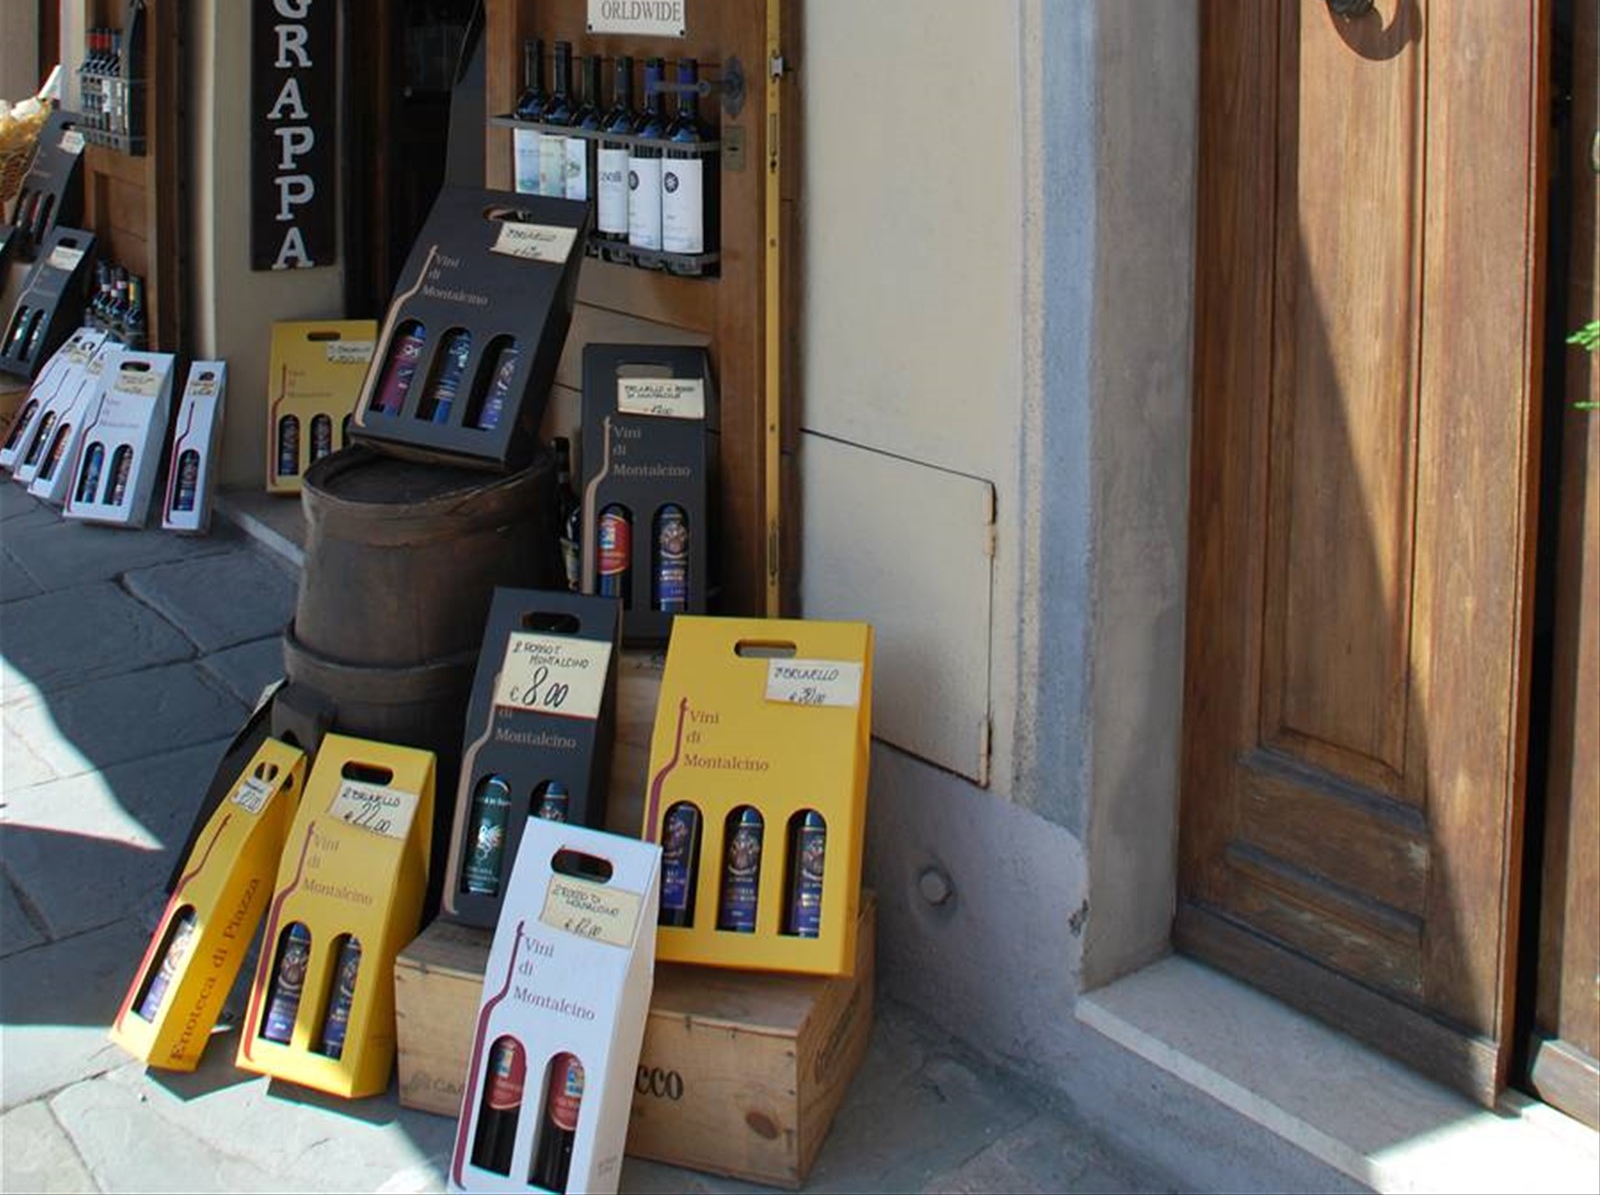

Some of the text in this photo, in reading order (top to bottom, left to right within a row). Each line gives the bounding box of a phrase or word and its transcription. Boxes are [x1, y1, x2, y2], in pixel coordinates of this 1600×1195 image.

[612, 426, 642, 439] Vini
[612, 444, 626, 455] di
[613, 463, 690, 477] Montalcino
[689, 710, 719, 724] Vini
[494, 727, 577, 748] Montalcino
[686, 729, 702, 743] di
[683, 754, 770, 772] Montalcino
[313, 833, 340, 853] Vini
[308, 853, 322, 869] di
[301, 878, 374, 907] Montalcino
[524, 937, 554, 958] Vini
[170, 877, 261, 1061] Enoteca di Piazza
[518, 960, 533, 976] di
[513, 985, 596, 1021] Montalcino
